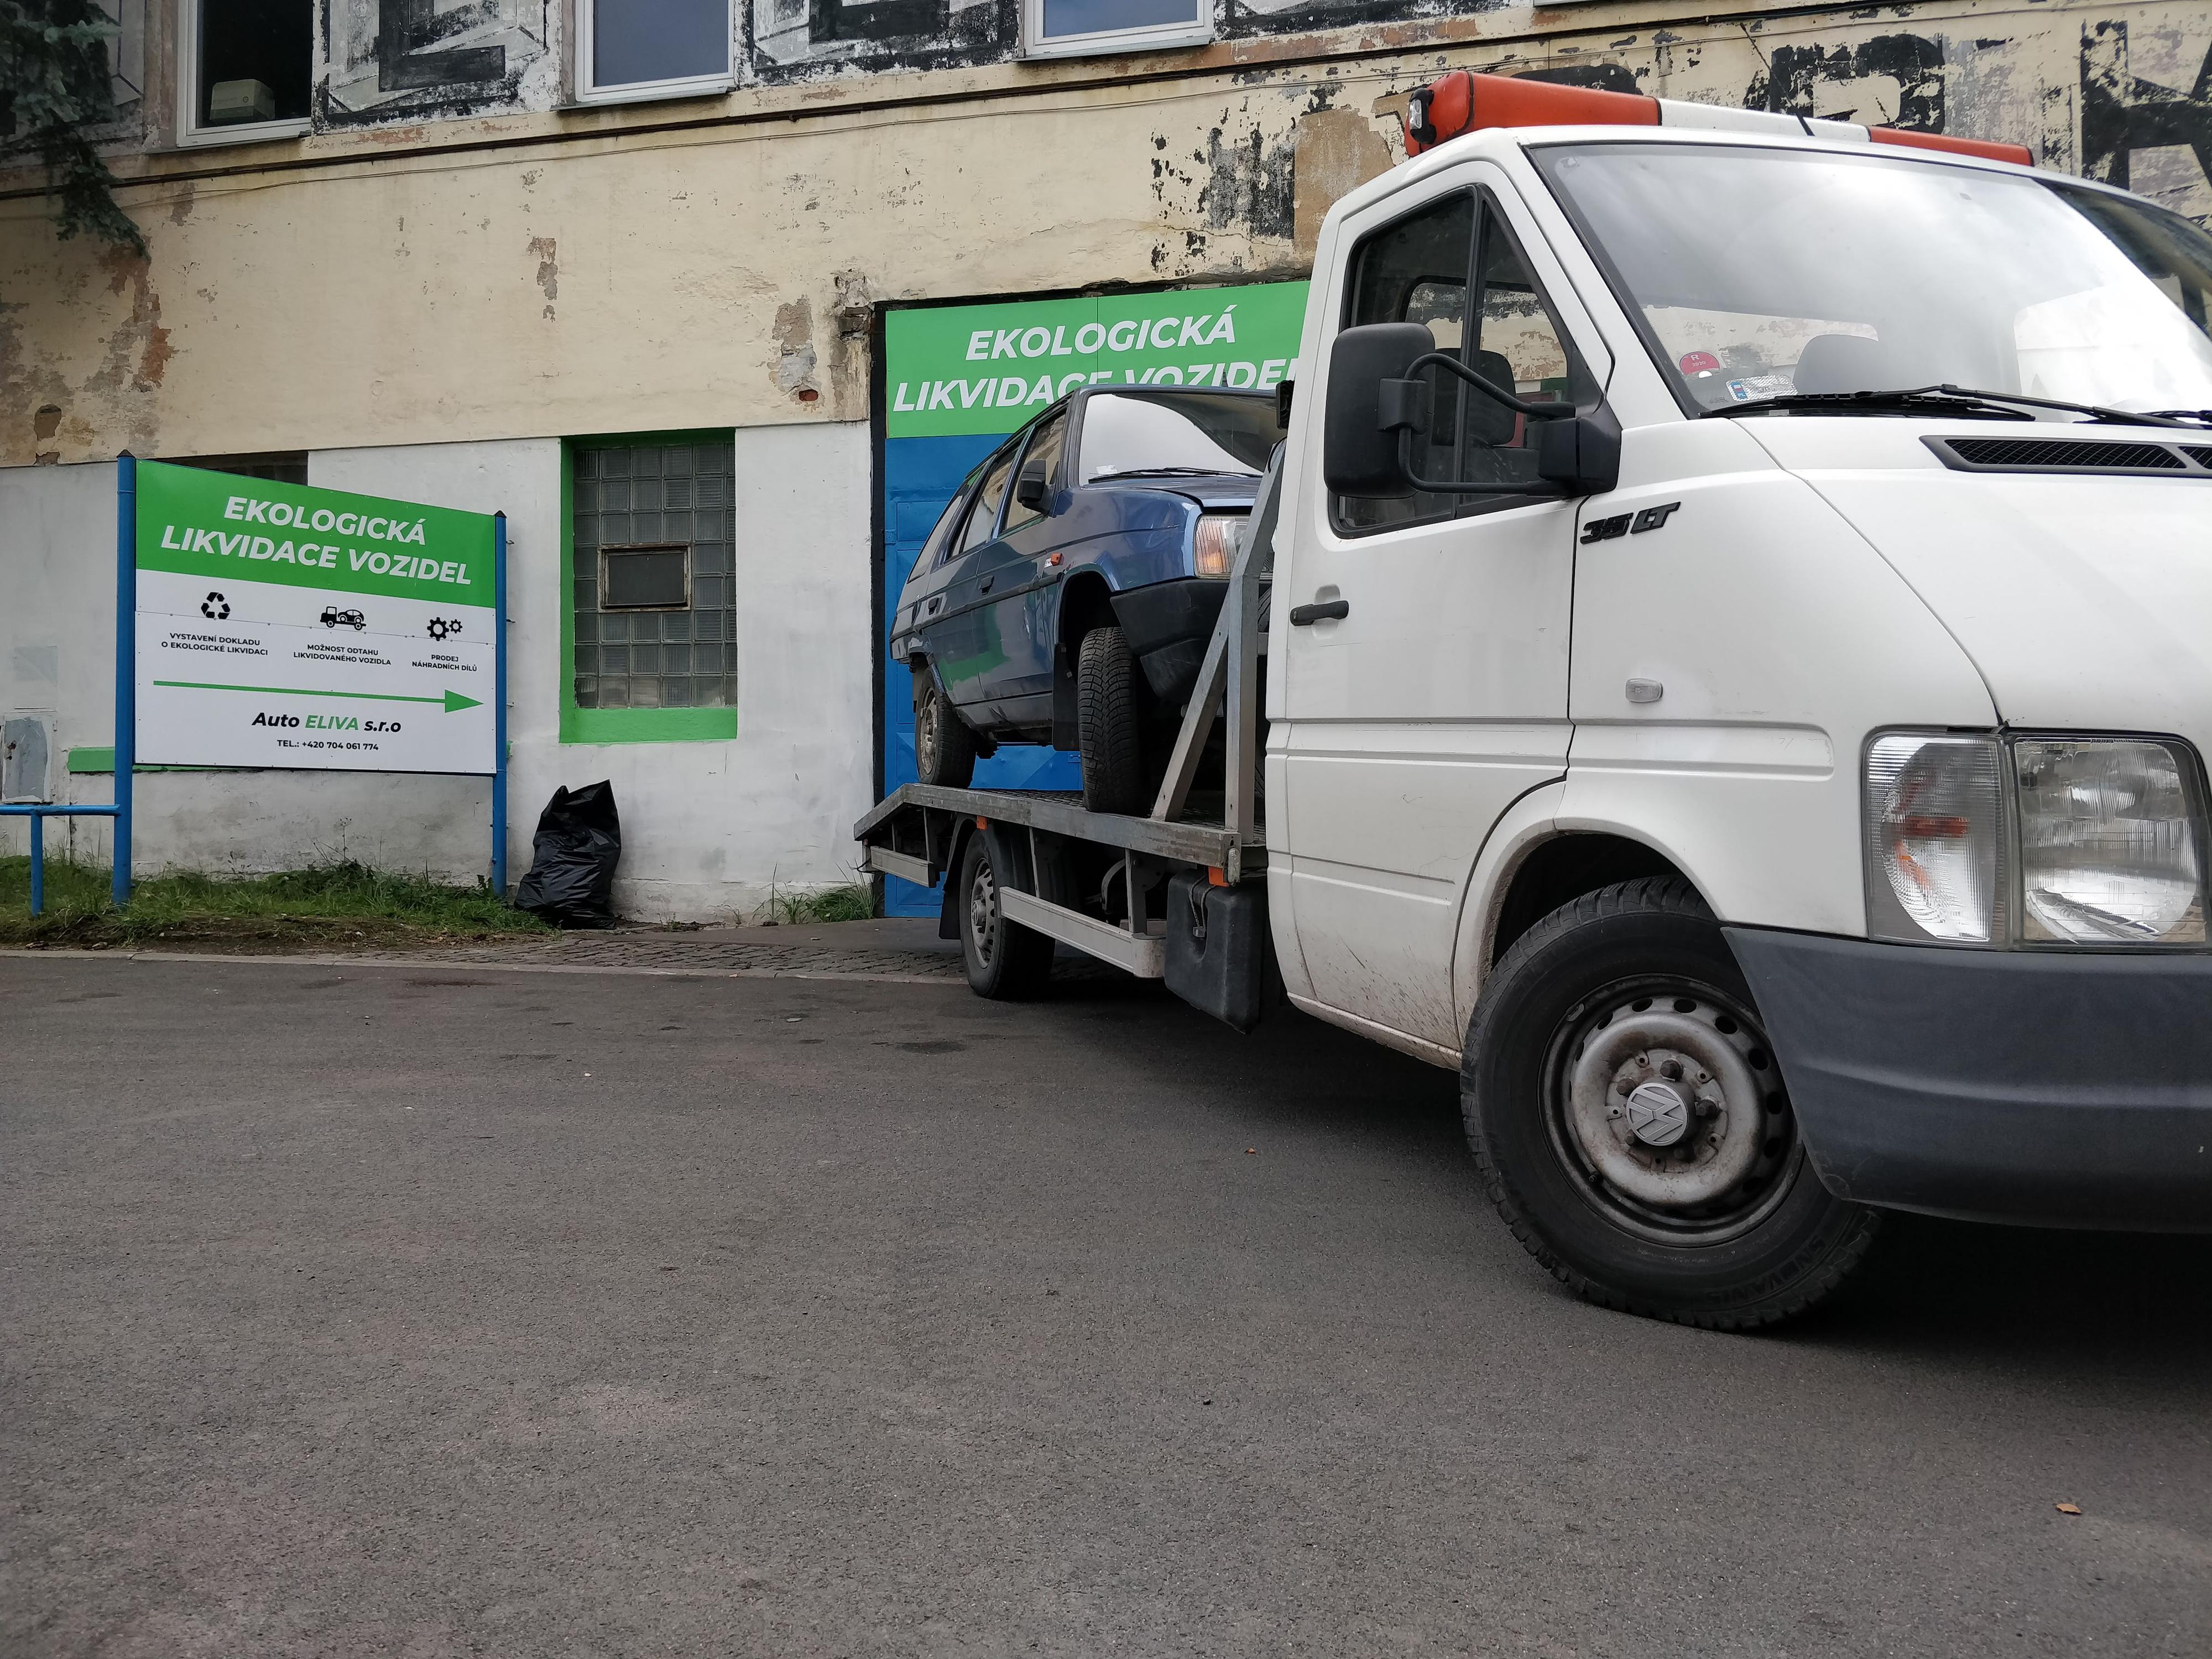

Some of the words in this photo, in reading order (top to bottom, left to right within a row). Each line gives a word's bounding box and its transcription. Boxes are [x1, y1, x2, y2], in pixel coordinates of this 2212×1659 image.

[965, 305, 1237, 361] EKOLOGICKÁ
[224, 497, 425, 545] EKOLOGICKÁ
[1580, 513, 1634, 544] 35
[1630, 502, 1681, 534] LT
[161, 525, 338, 568] LIKVIDACE
[349, 549, 471, 585] VOZIDEL
[170, 633, 217, 642] VYSTAVENÍ
[220, 637, 260, 645] DOKLADU
[171, 642, 225, 651] EKOLOGICKÉ
[227, 647, 268, 655] LIKVIDACI
[307, 644, 345, 652] MOŽNOST
[294, 652, 357, 662] LIKVIDOVANÉHO
[412, 660, 459, 670] NÁHRADNÍCH
[252, 713, 300, 727] Auto
[305, 715, 358, 730] ELIVA
[364, 721, 401, 732] s.r.o
